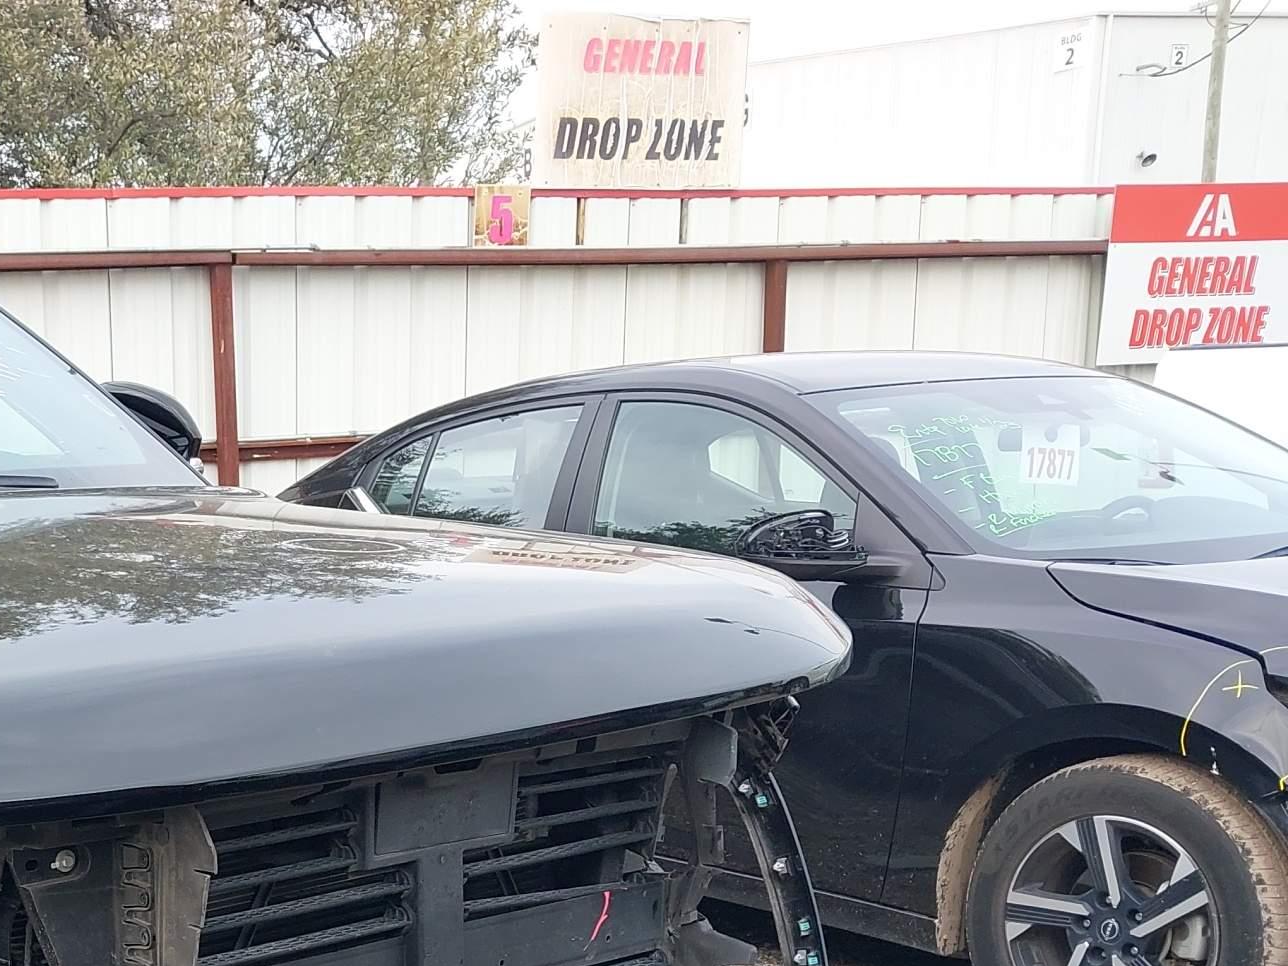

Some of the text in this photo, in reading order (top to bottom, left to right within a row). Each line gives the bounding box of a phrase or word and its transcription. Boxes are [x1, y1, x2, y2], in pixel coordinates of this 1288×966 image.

[583, 37, 706, 76] GENERAL
[1061, 33, 1082, 45] BLDG
[1065, 48, 1074, 65] 2
[1175, 51, 1184, 65] 2
[553, 116, 725, 161] DROP ZONE
[487, 195, 513, 246] 5
[1146, 254, 1260, 298] GENERAL
[1128, 305, 1271, 350] DROP ZONE
[1026, 446, 1075, 481] 17877
